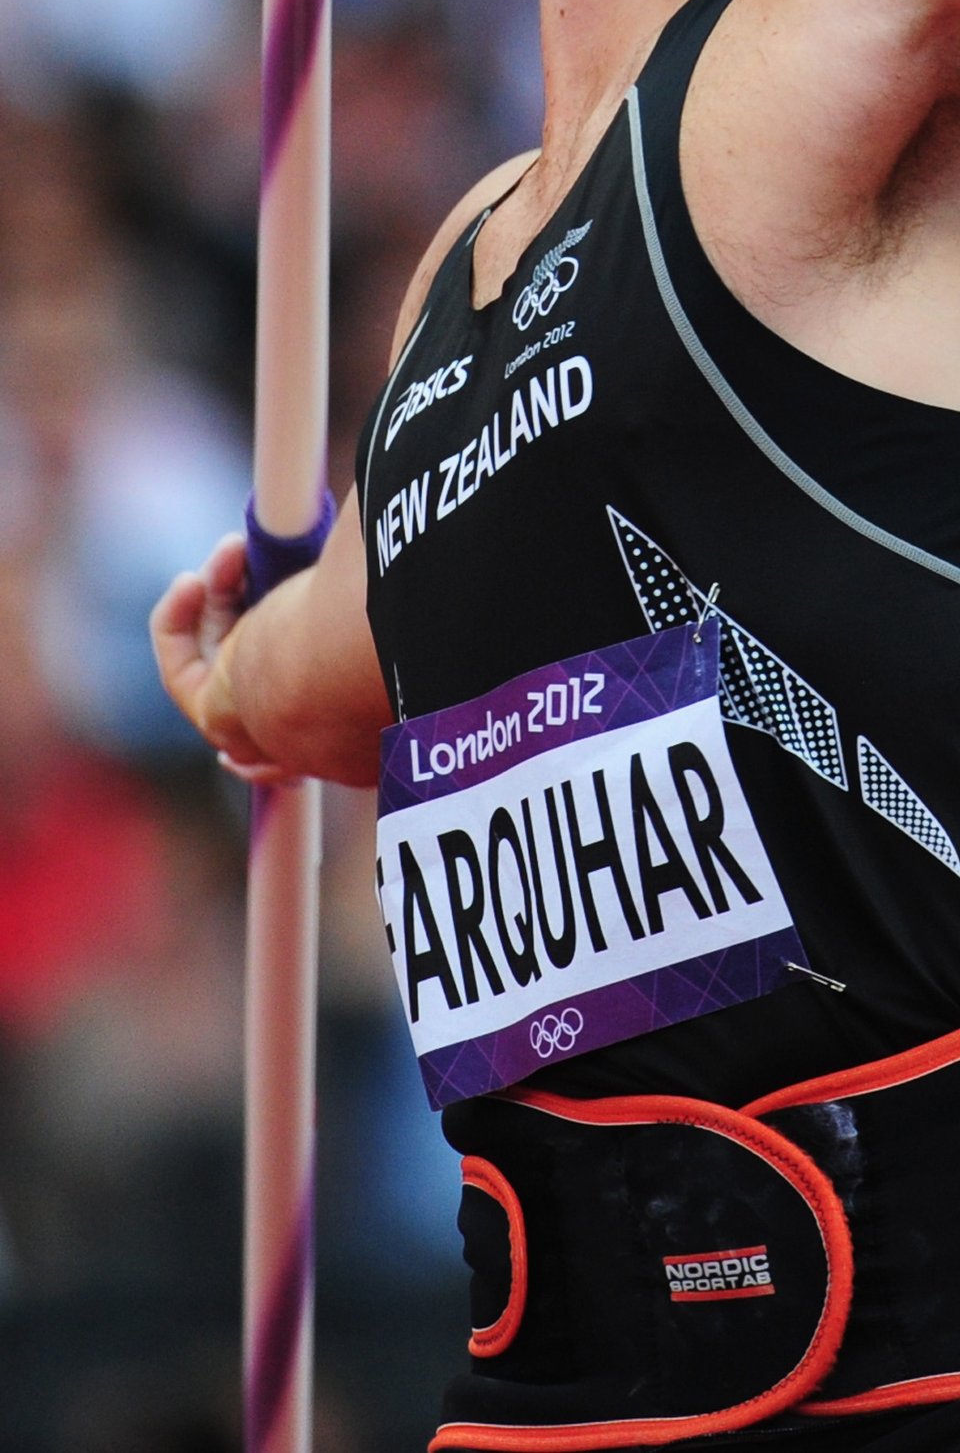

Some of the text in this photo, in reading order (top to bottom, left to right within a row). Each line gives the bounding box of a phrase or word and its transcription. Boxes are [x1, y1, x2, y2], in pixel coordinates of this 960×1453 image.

[503, 321, 576, 380] London 2012
[376, 355, 594, 578] NEW ZEALAND
[410, 673, 606, 783] London 2012
[665, 1254, 769, 1279] NORDIC
[669, 1271, 772, 1292] SPORT AB
